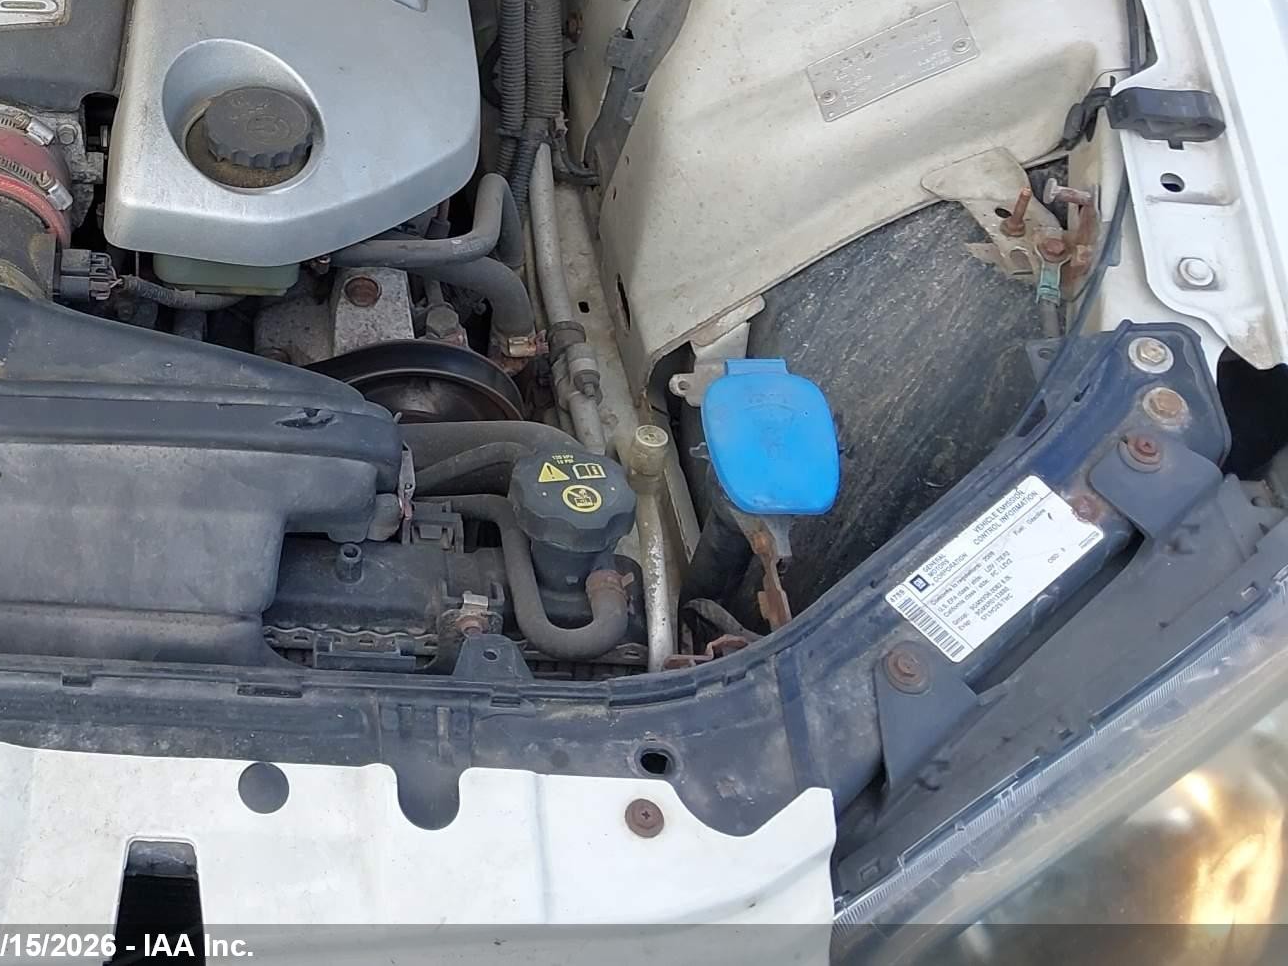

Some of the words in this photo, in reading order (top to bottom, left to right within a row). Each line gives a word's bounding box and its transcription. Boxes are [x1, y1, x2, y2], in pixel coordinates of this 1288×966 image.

[972, 510, 999, 534] VEHICLE
[996, 488, 1025, 513] EMISSION
[972, 520, 1001, 545] CONTROL
[998, 489, 1038, 523] INFORMATION
[922, 552, 946, 573] GENERAL
[927, 558, 950, 578] MOTORS
[932, 551, 968, 583] CORPORATION
[942, 597, 965, 618] California
